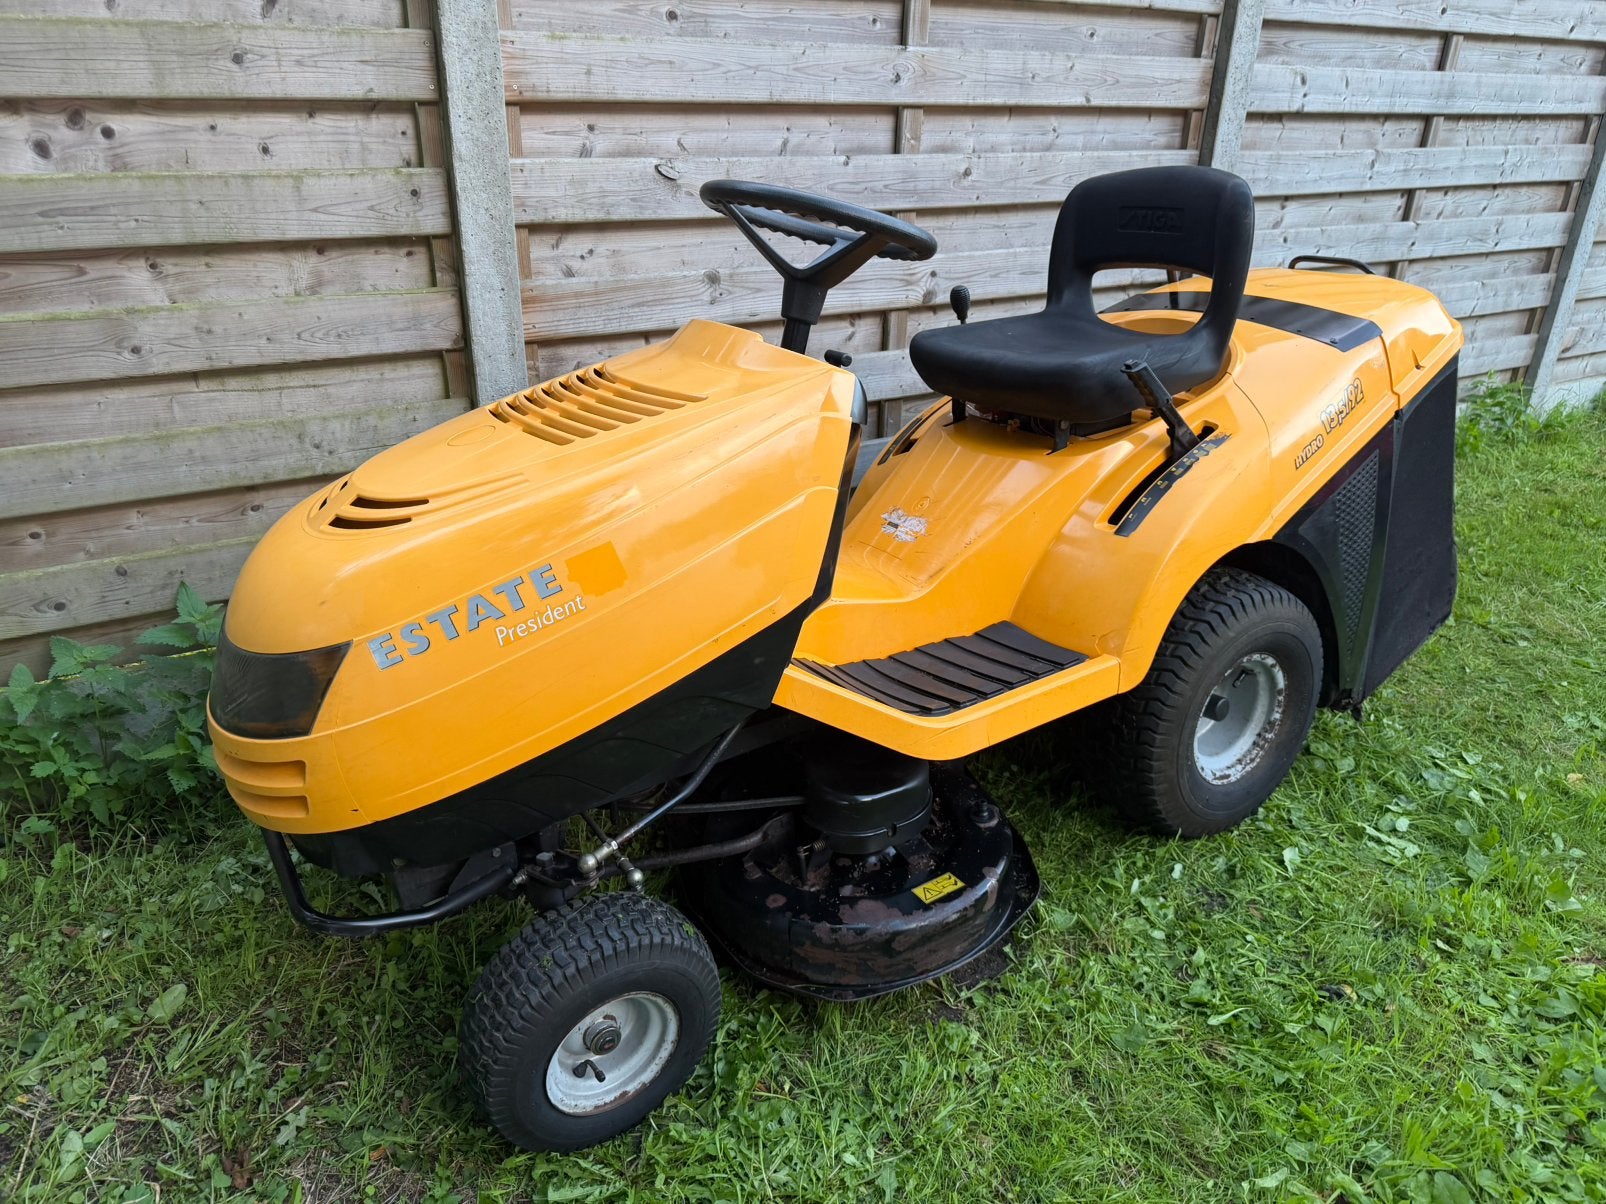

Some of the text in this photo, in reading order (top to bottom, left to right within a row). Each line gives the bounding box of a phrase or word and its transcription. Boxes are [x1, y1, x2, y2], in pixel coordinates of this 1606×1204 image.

[1294, 433, 1325, 470] HYDRO
[366, 562, 563, 672] ESTATE
[495, 594, 587, 648] President
